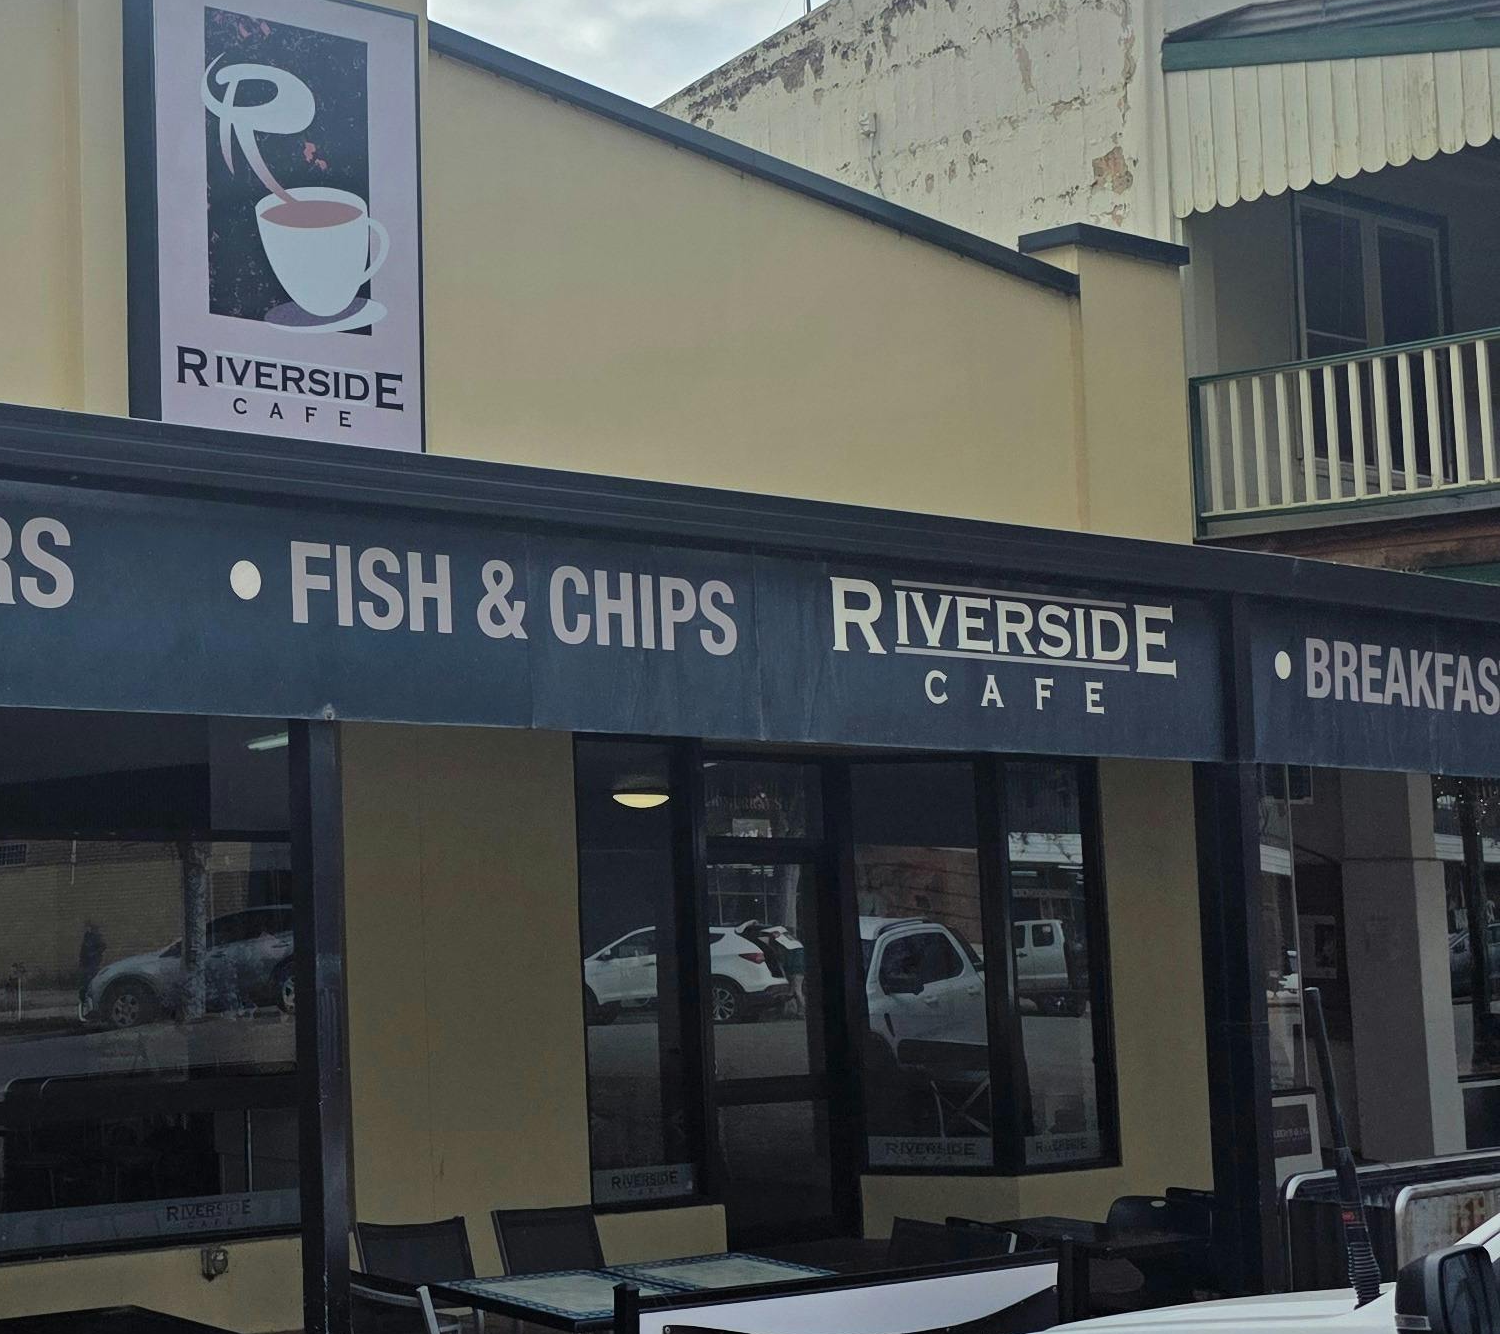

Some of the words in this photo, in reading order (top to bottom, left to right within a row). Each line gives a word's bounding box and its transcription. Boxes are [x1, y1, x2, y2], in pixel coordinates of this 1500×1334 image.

[176, 345, 404, 411] RIVERSIDE
[232, 396, 353, 428] CAFE
[290, 540, 453, 634] FISH
[476, 559, 529, 640] &
[549, 565, 738, 656] CHIPS
[829, 576, 1178, 678] RIVERSIDE
[924, 670, 1105, 715] CAFE
[1305, 637, 1500, 715] BREAKFAS
